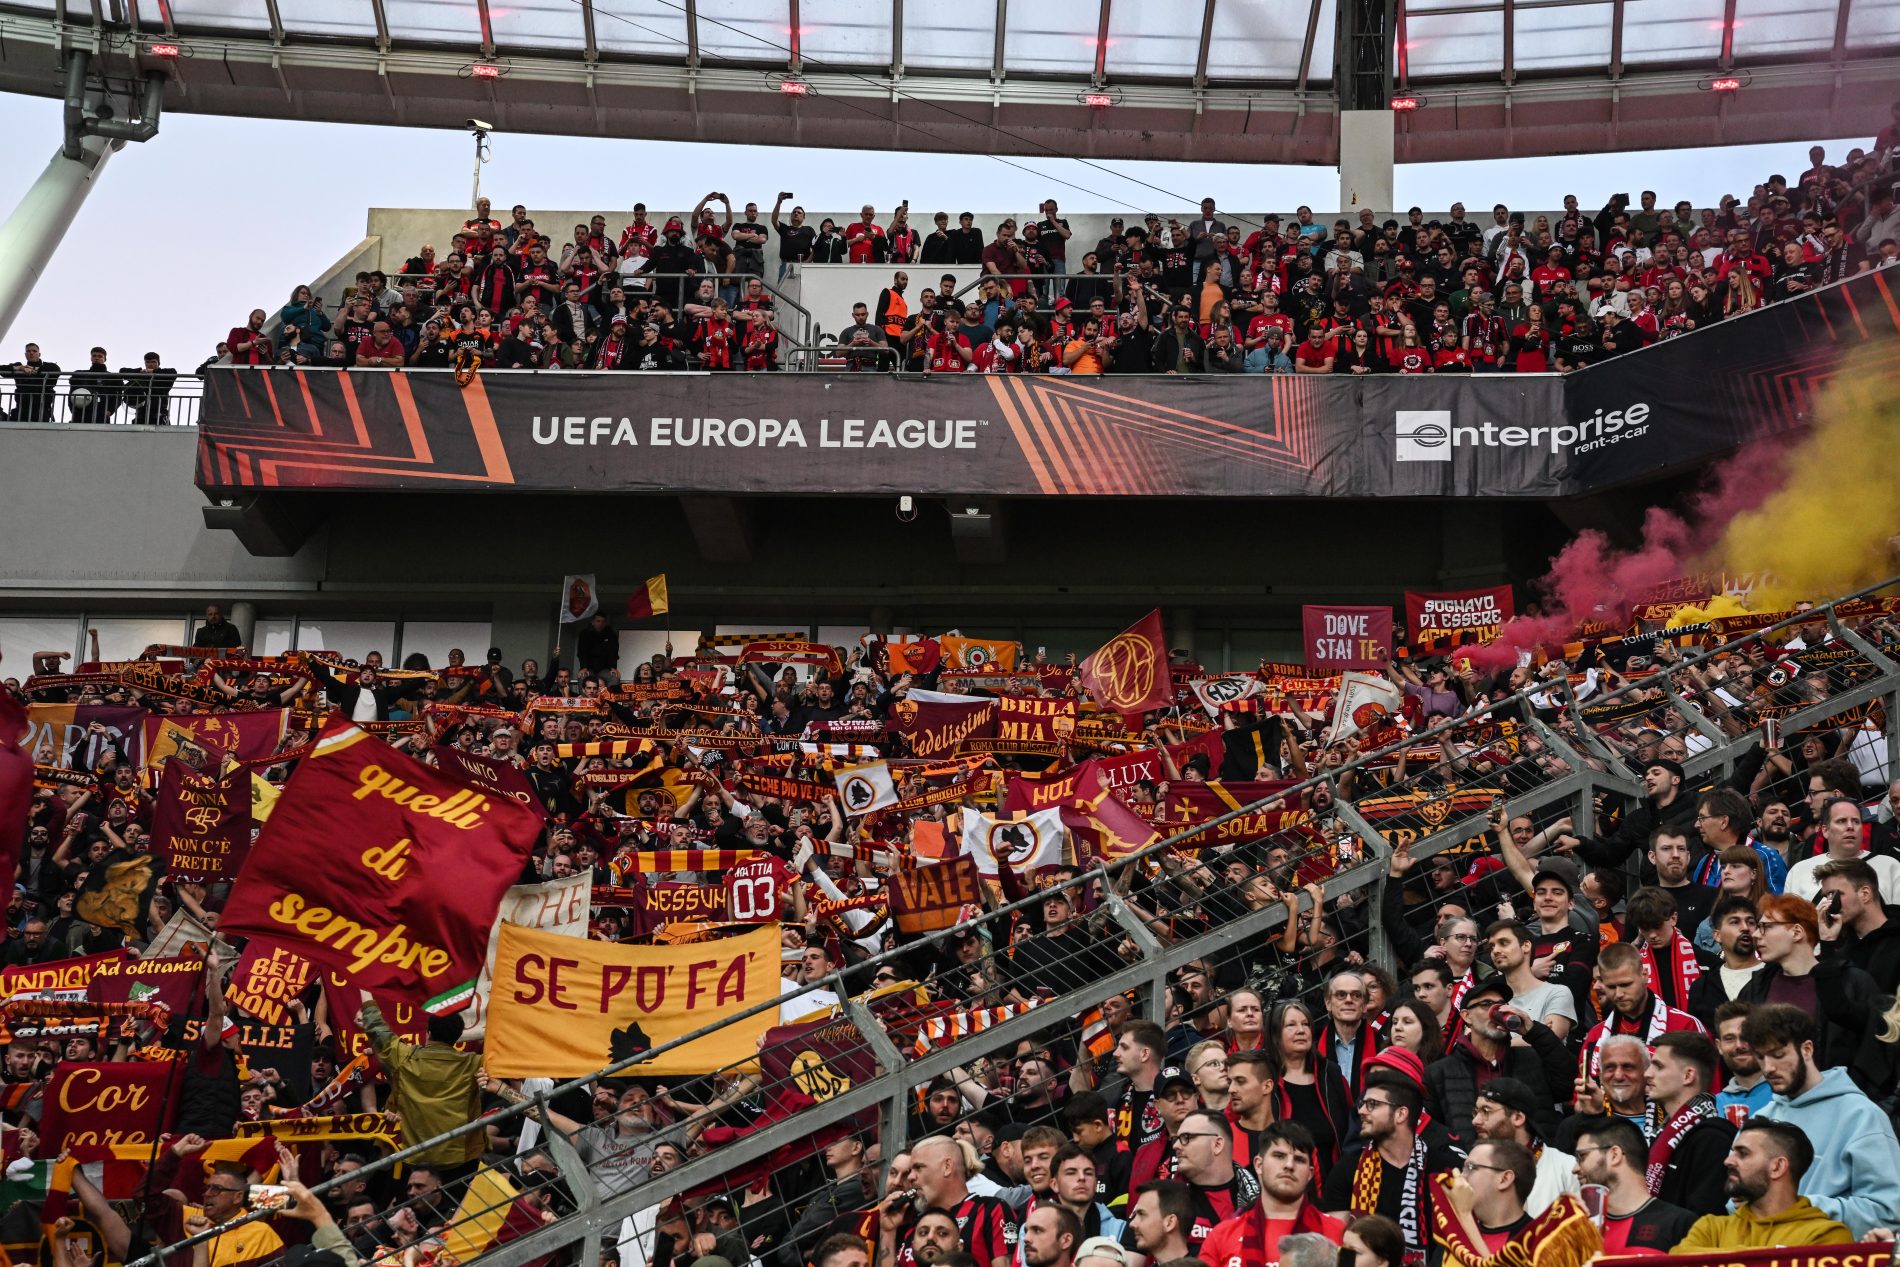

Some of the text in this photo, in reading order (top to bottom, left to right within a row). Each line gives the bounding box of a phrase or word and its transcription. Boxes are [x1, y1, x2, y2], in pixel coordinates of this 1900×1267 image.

[1572, 343, 1594, 352] BOSS
[532, 416, 638, 446] UEFA
[650, 418, 807, 448] EUROPA
[1396, 403, 1650, 454] enterprise
[1575, 424, 1650, 455] rent-a-car
[1425, 595, 1495, 613] SOGNAVO
[1324, 615, 1369, 637] DOVE
[1420, 609, 1502, 628] DI ESSERE
[1728, 615, 1753, 629] NEW
[1755, 611, 1789, 624] YORK
[769, 641, 810, 652] SPQR
[1359, 639, 1378, 660] TE
[1272, 663, 1303, 677] ROMA
[1001, 696, 1076, 716] BELLA
[830, 731, 890, 743] ROMA
[1000, 720, 1045, 742] MIA
[969, 741, 995, 752] ROMA
[996, 742, 1019, 752] CLUB
[1108, 761, 1154, 788] LUX
[178, 789, 228, 806] DONNA
[353, 764, 490, 830] quelli
[760, 778, 781, 795] CHE
[781, 780, 798, 799] DIO
[926, 783, 968, 804] BRUXELLES
[1217, 814, 1268, 840] SOLA
[168, 836, 198, 853] NON
[171, 854, 223, 871] PRETE
[362, 838, 413, 881] di
[734, 862, 773, 878] MATTIA
[896, 860, 976, 911] VALE
[510, 882, 585, 929] CHE
[732, 876, 775, 920] 03
[93, 958, 203, 977] Ad oltranza
[514, 953, 579, 1010] SE
[223, 983, 284, 1027] NON
[40, 1023, 99, 1037] roma
[59, 1068, 149, 1113] Cor
[1671, 1105, 1702, 1130] ROAD
[1700, 1100, 1714, 1111] TO
